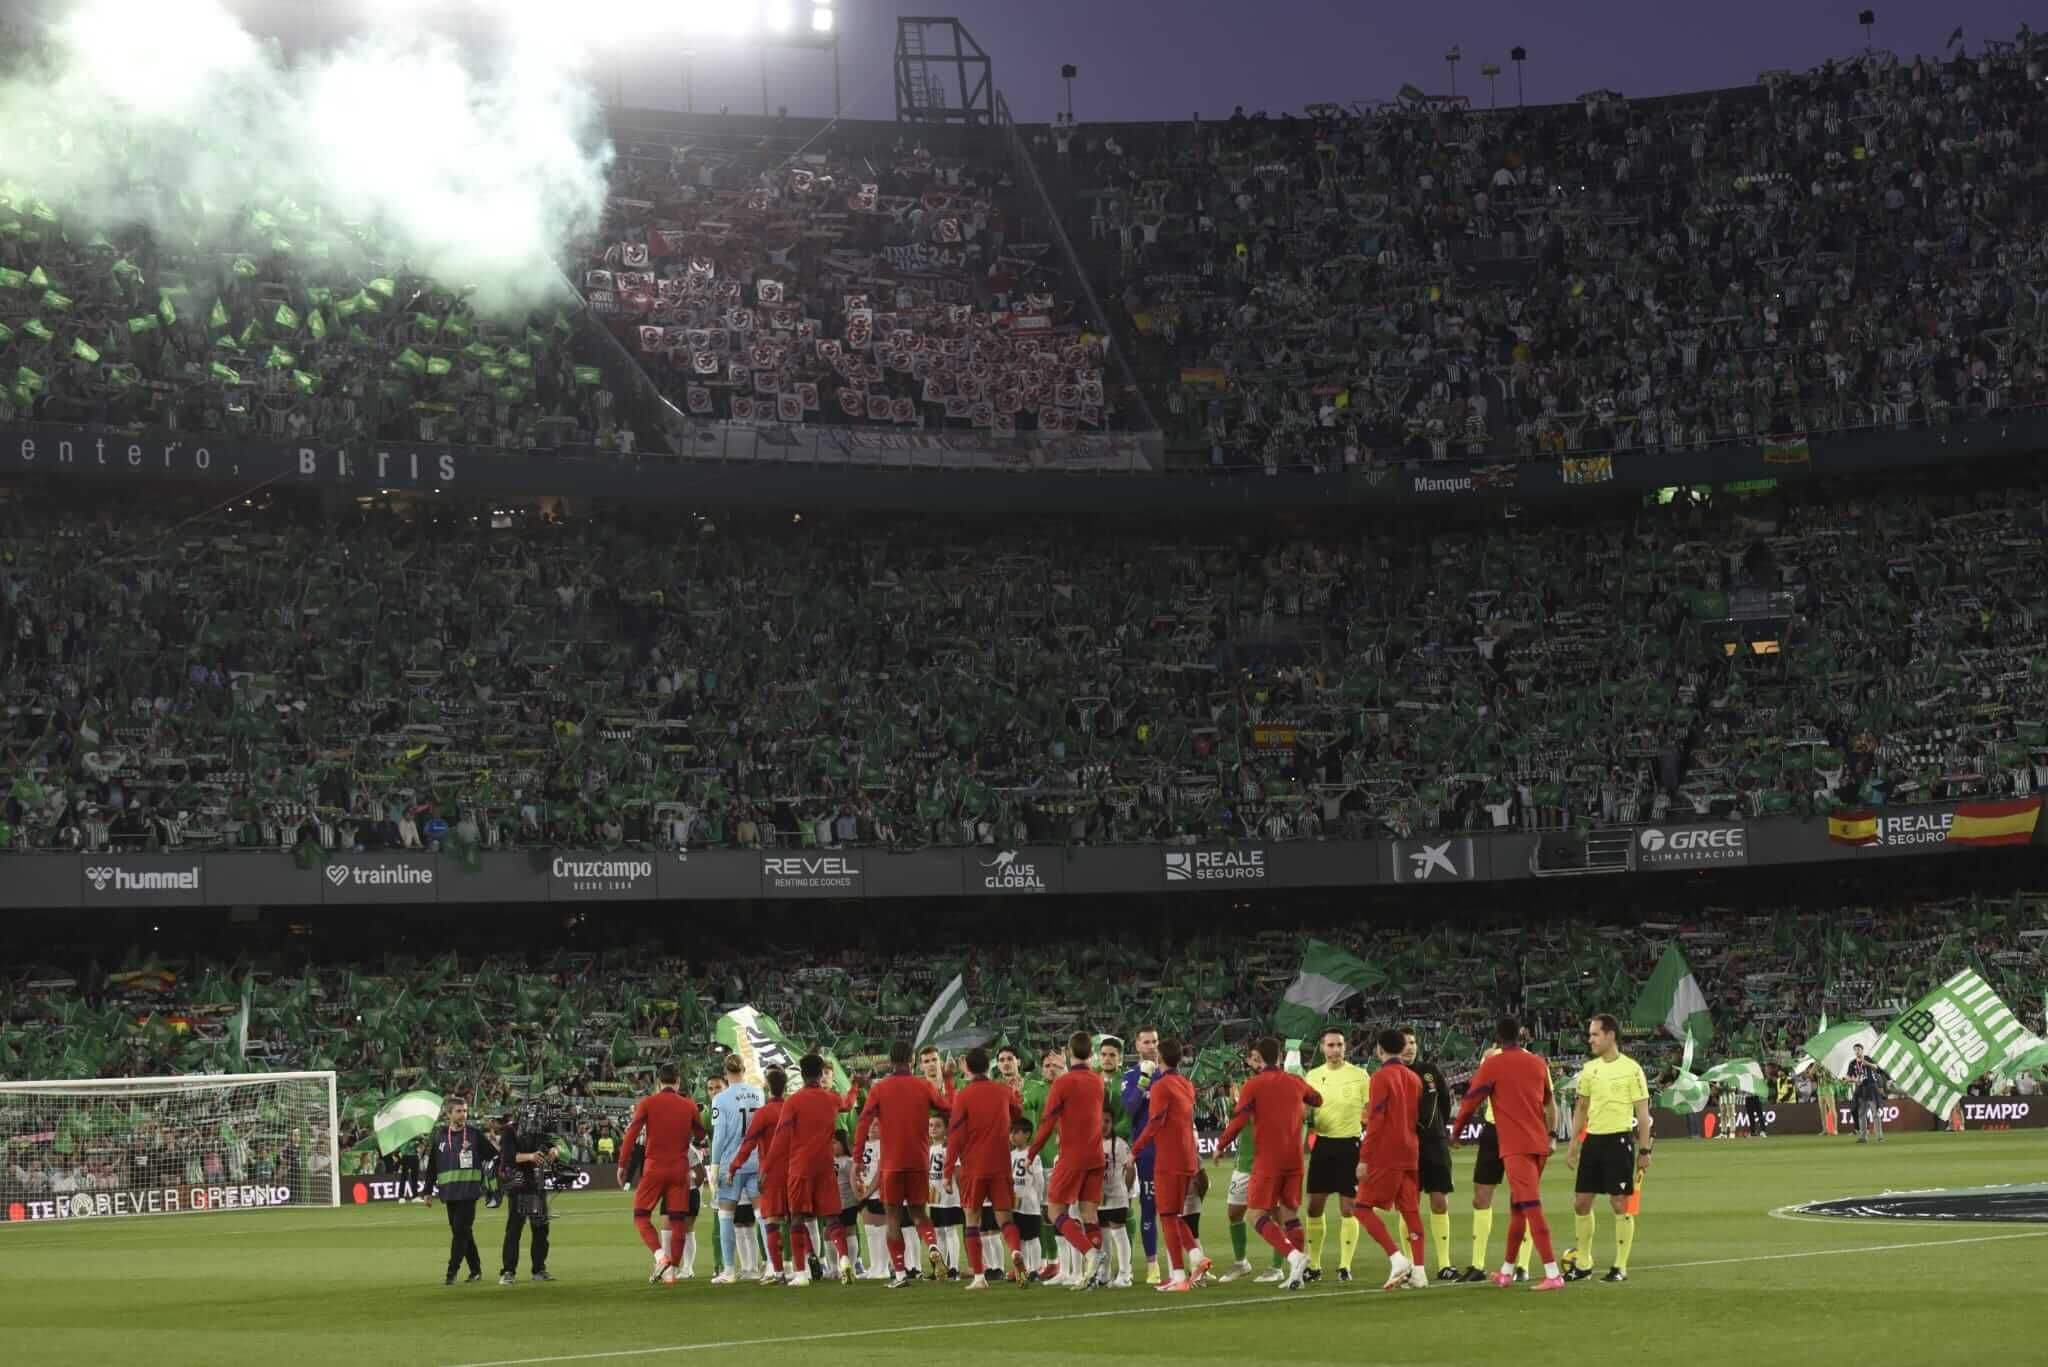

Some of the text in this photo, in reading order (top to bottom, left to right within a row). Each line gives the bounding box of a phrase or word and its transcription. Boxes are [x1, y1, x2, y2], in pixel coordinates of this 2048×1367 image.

[1888, 813, 1954, 832] REALE
[1669, 828, 1745, 849] GREE
[1888, 832, 1951, 846] SEGURO
[1195, 849, 1265, 867] REALE
[1641, 849, 1745, 862] CLIMATIZACIÓN
[353, 863, 433, 885] trainline
[552, 856, 653, 881] Cruzcampo
[764, 857, 861, 876] REVEL
[1004, 863, 1036, 876] AUS
[1196, 867, 1265, 880] SEGUROS
[114, 866, 199, 889] hummel
[985, 875, 1047, 889] GLOBAL
[1927, 997, 1990, 1064] MUCHO
[1964, 1102, 2030, 1120] TEMPLO
